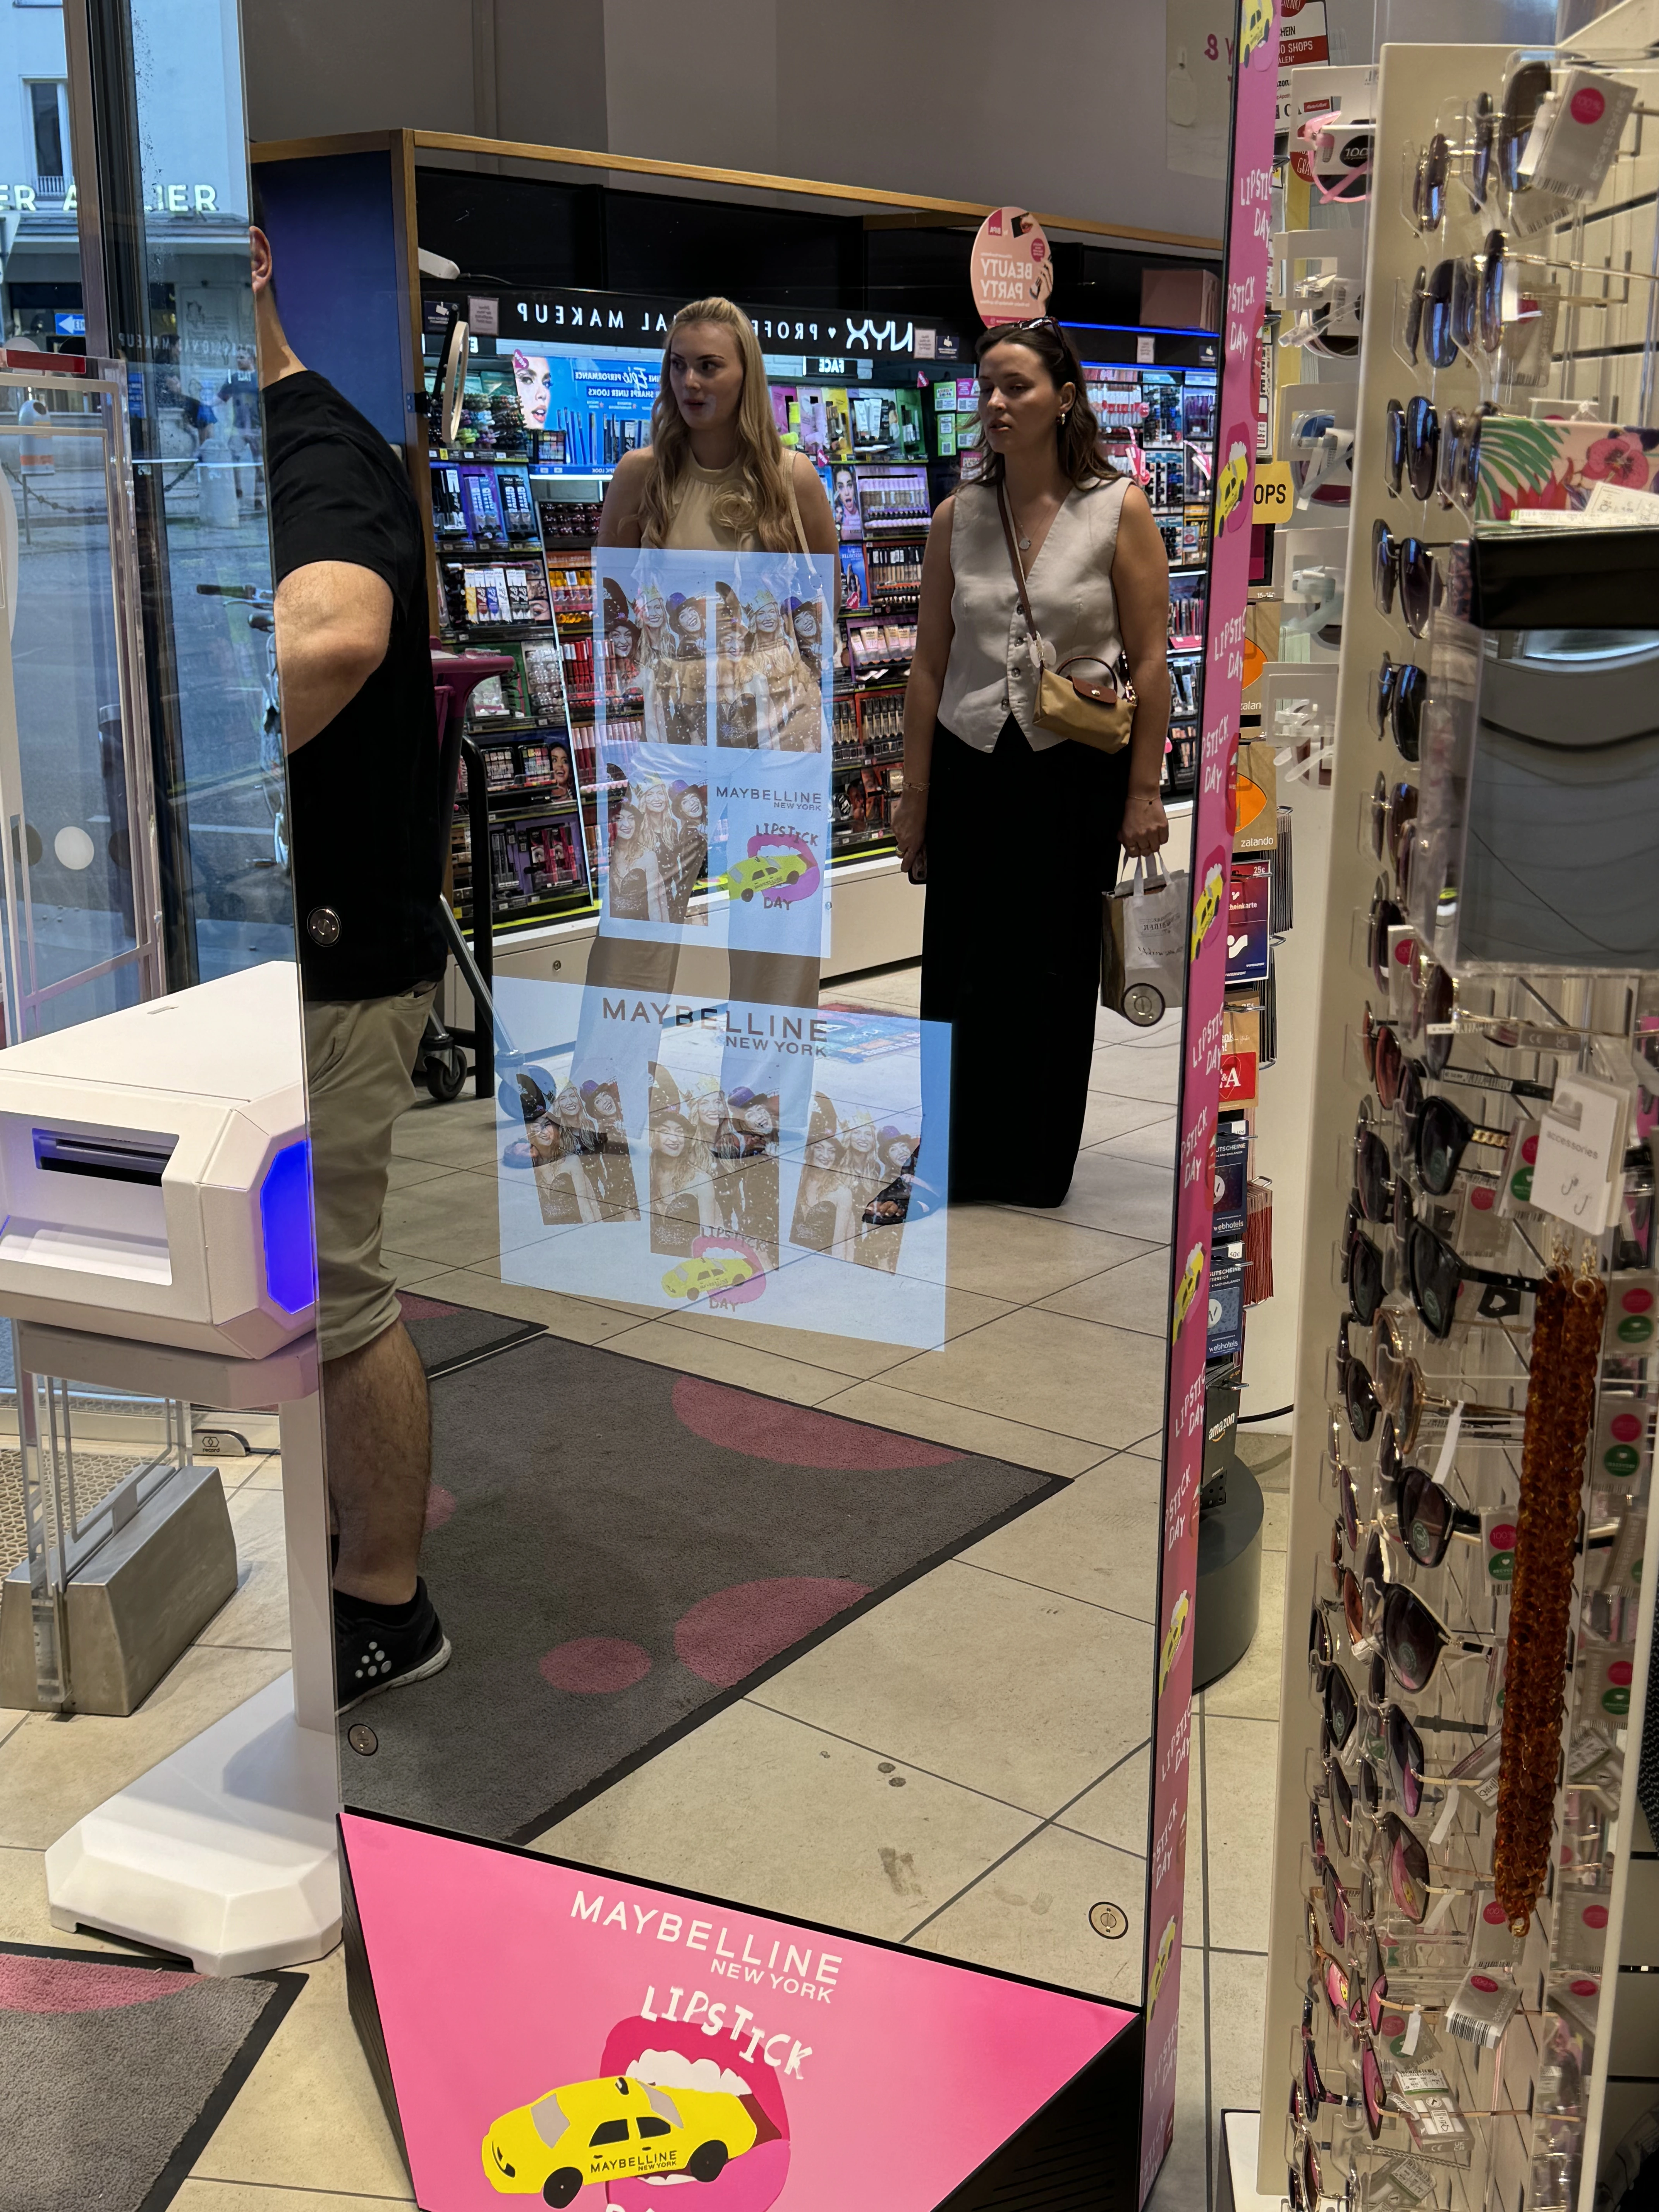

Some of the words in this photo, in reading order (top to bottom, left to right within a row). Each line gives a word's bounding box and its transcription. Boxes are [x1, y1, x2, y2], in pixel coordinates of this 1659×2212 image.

[1288, 41, 1313, 53] SHOPS
[1241, 166, 1273, 206] LIPSTIC
[1254, 208, 1271, 248] DAY
[1227, 276, 1255, 314] PSTICK
[1230, 321, 1248, 361] DAY
[1254, 483, 1286, 506] OPS
[1214, 606, 1246, 661] LIPSTIC
[1227, 650, 1243, 682] DAY
[1201, 714, 1229, 764] PSTICK
[716, 786, 822, 805] MAYBELLINE
[1205, 763, 1222, 793] DAY
[774, 801, 795, 809] NEW
[797, 802, 822, 811] YORK
[756, 823, 819, 847] LIPSTICK
[1240, 836, 1274, 848] zalando
[764, 896, 792, 910] DAY
[603, 997, 829, 1042] MAYBELLINE
[1193, 1002, 1223, 1068] LIPSTIC
[725, 1034, 769, 1051] NEW
[771, 1040, 828, 1058] YORK
[1206, 1045, 1221, 1075] DAY
[1180, 1106, 1207, 1165] PSTICK
[1546, 1130, 1599, 1160] accessories
[1184, 1156, 1201, 1189] DAY
[1213, 1220, 1244, 1231] webhotels
[709, 1297, 739, 1312] DAY
[1209, 1340, 1238, 1352] webhotels
[1175, 1361, 1206, 1438] LIPSTIC
[1188, 1403, 1204, 1437] DAY
[1208, 1412, 1235, 1441] amazon
[1165, 1464, 1191, 1532] PSTICK
[1168, 1513, 1185, 1551] DAY
[1162, 1695, 1192, 1782] LIPSTIC
[1175, 1737, 1190, 1774] DAY
[1156, 1846, 1173, 1890] DAY
[570, 1890, 843, 1985] MAYBELLINE
[710, 1959, 764, 1984] NEW
[769, 1973, 834, 2004] YORK
[640, 1985, 812, 2080] LIPSTICK
[1149, 2011, 1178, 2102] LIPSTIC
[1163, 2047, 1177, 2088] DAY
[590, 2150, 678, 2173] MAYBELLINE
[637, 2163, 655, 2171] NEW
[656, 2160, 677, 2169] YORK
